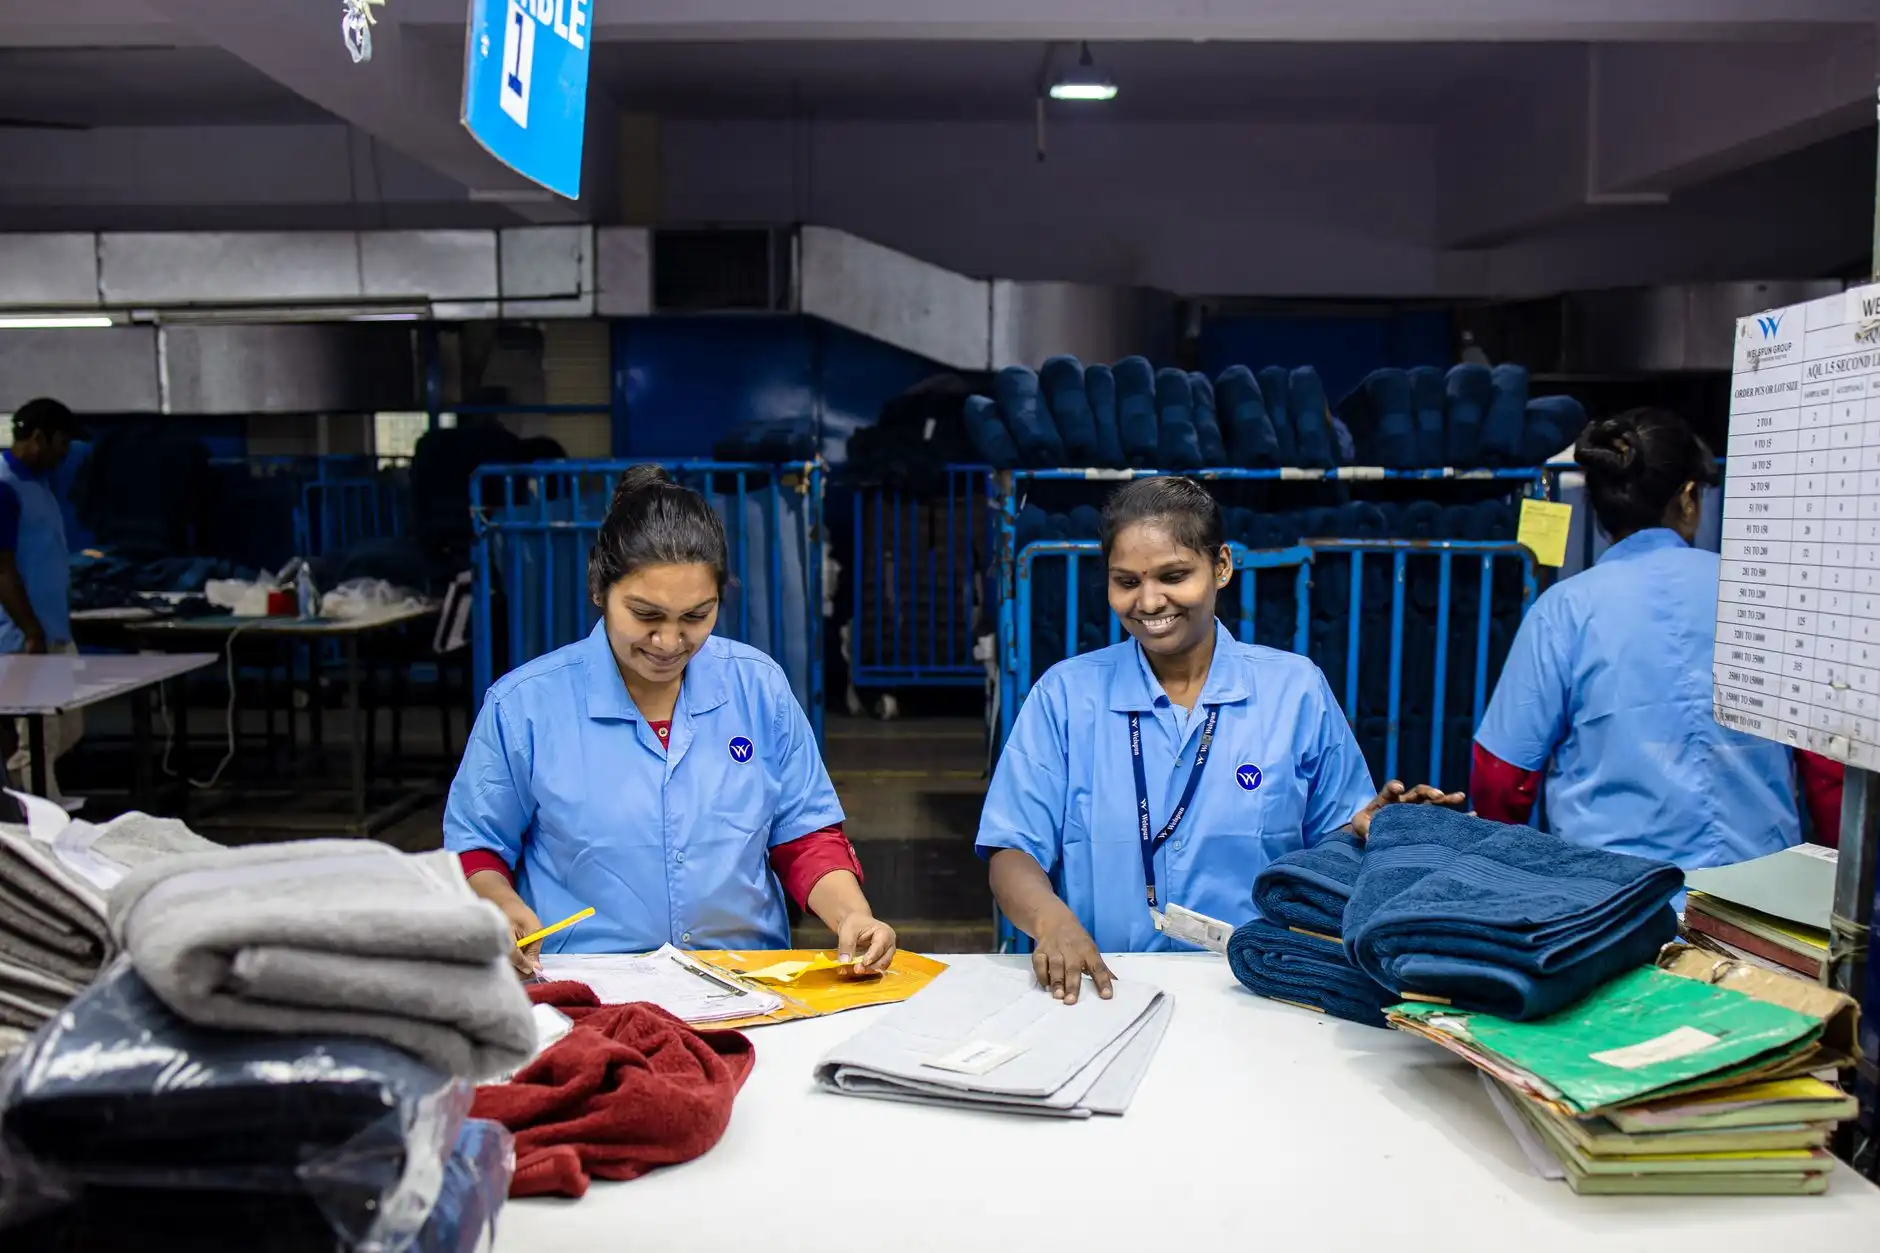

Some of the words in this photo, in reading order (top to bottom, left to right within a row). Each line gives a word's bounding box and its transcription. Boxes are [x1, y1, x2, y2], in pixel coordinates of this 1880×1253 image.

[508, 11, 523, 98] 1
[1773, 342, 1792, 354] GROUP
[1807, 362, 1823, 379] AQL
[1835, 355, 1870, 372] SECOND
[1734, 387, 1754, 399] ORDER
[1141, 813, 1149, 840] Welspun
[1168, 807, 1185, 830] Welspun
